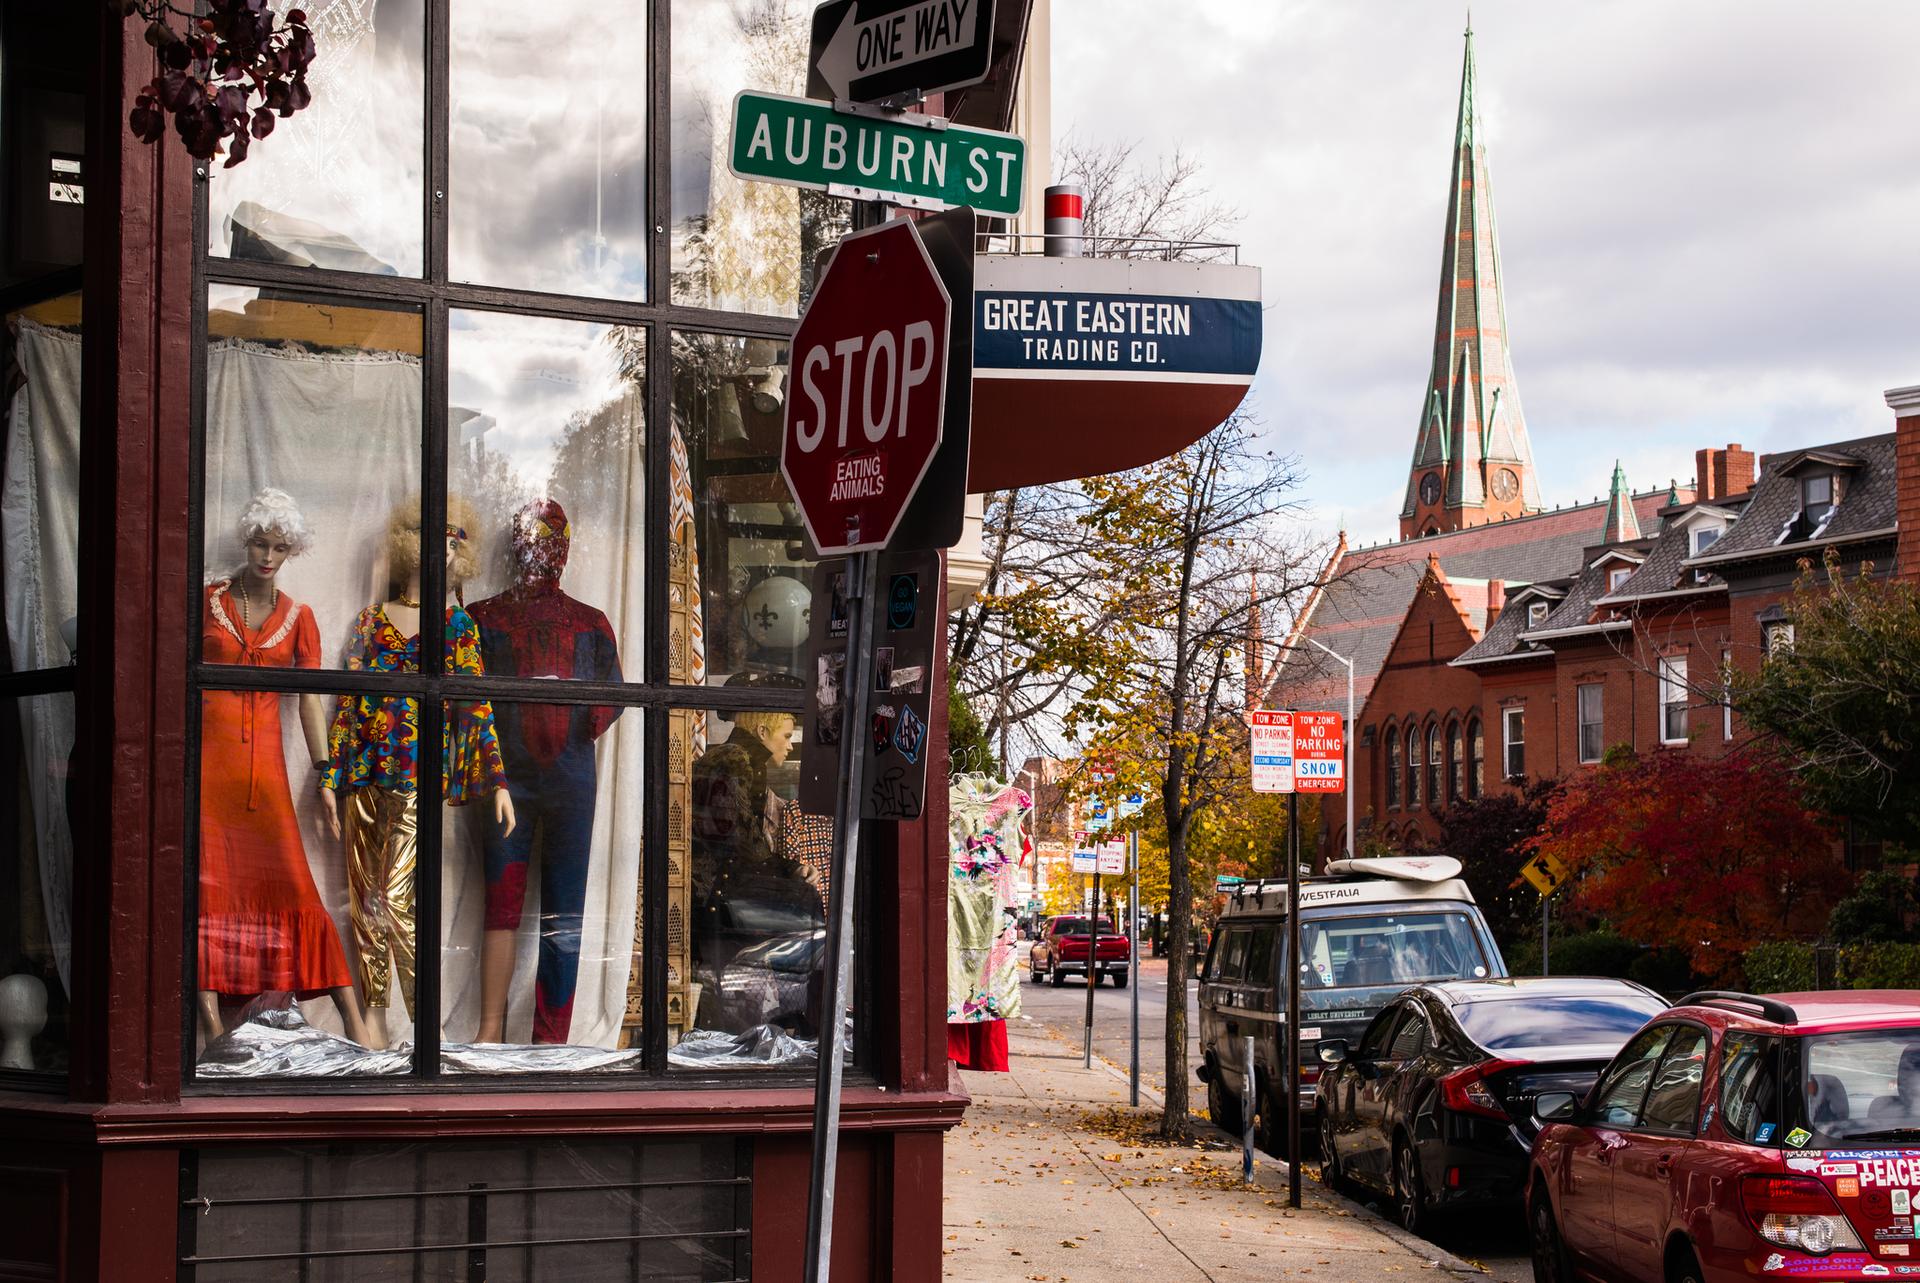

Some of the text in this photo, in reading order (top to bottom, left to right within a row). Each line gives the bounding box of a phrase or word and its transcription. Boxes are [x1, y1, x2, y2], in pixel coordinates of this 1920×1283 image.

[856, 0, 969, 72] ONE WAY
[746, 113, 1017, 197] AUBURN ST
[983, 298, 1190, 336] GREAT EASTERN
[1022, 338, 1166, 364] TRADING CO.
[796, 320, 934, 453] STOP
[836, 456, 881, 481] EATING
[829, 475, 885, 501] ANIMALS
[897, 587, 909, 598] GO
[1255, 714, 1289, 725] TOW ZONE
[1300, 716, 1336, 725] TOW ZONE
[1254, 728, 1291, 740] NO PARKING
[1310, 726, 1325, 737] NO
[1295, 738, 1341, 751] PARKING
[1301, 762, 1336, 775] SNOW
[1297, 779, 1341, 788] EMERGENCY
[1299, 888, 1360, 901] WESTFALIA
[1307, 1010, 1365, 1020] LESLEY UNIVERSITY
[1783, 1258, 1829, 1266] KOOKS
